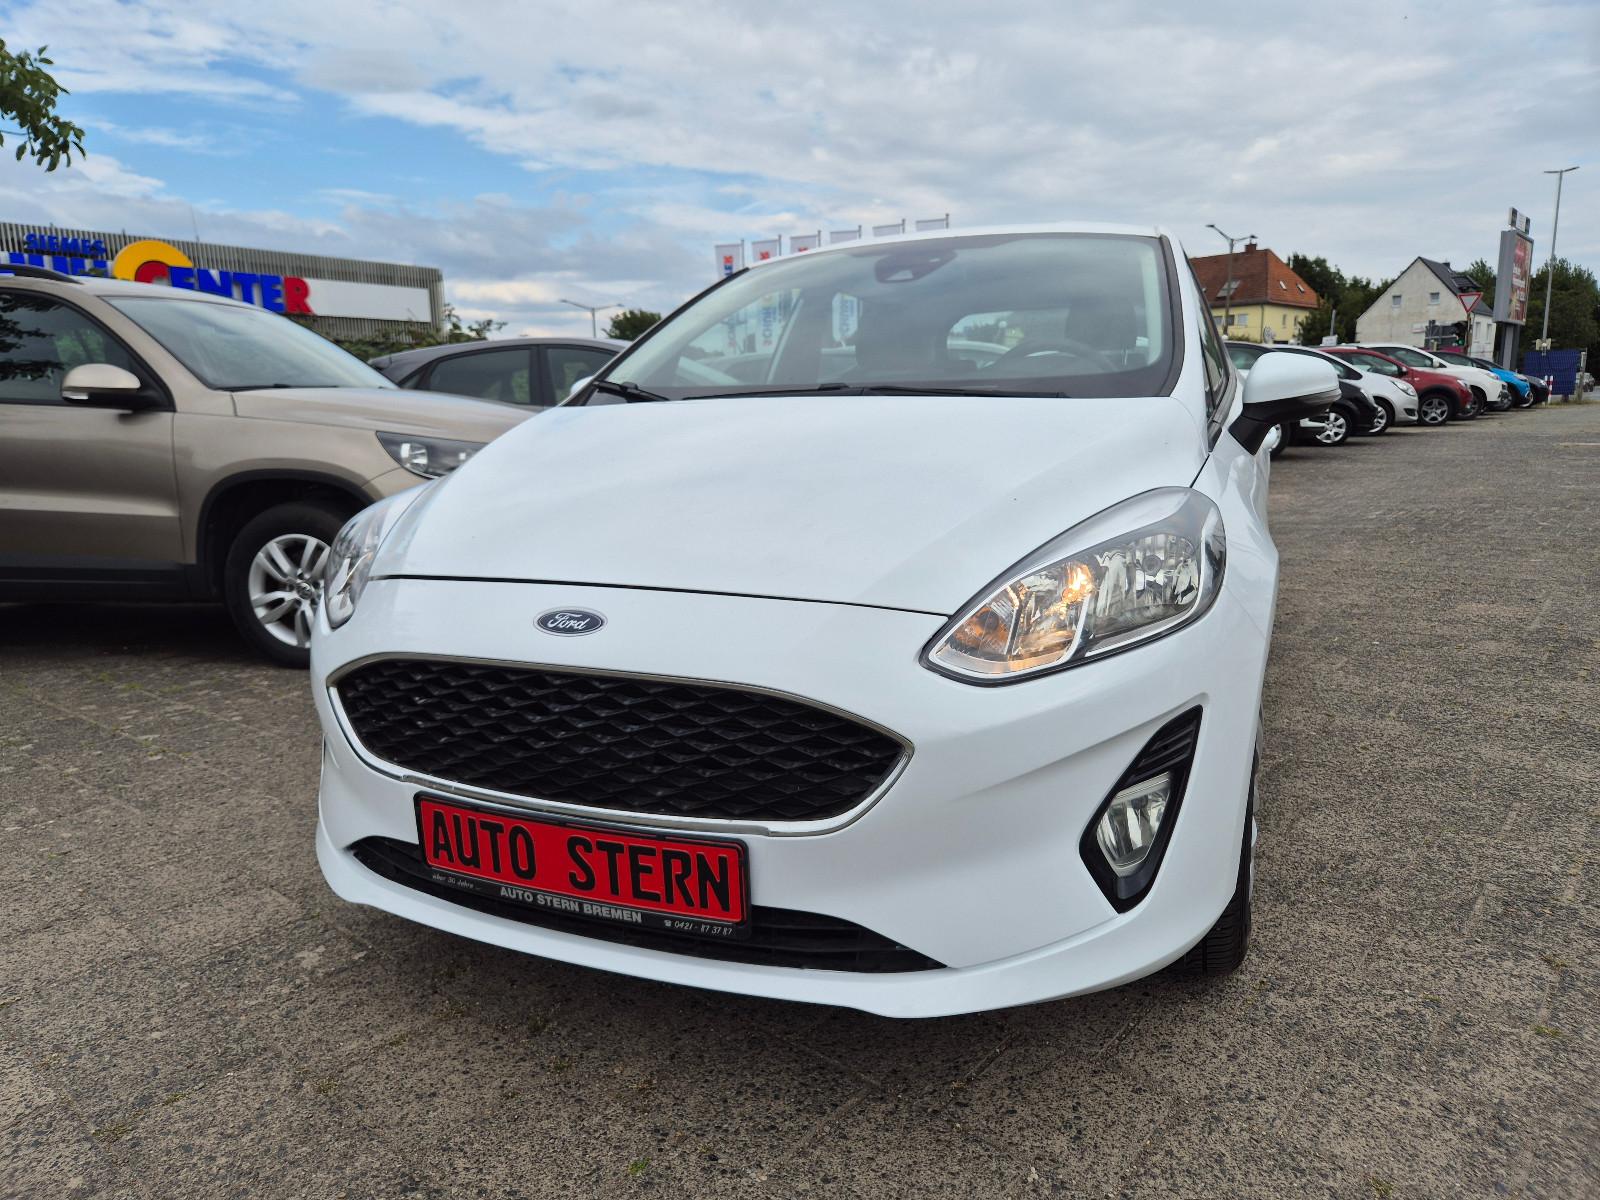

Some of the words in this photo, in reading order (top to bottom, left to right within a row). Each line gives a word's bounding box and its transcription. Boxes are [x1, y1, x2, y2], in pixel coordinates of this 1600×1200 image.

[24, 232, 107, 256] SIEMES
[112, 239, 314, 316] CENTER
[547, 612, 590, 629] Ford
[432, 810, 537, 880] AUTO
[567, 835, 731, 912] STERN
[500, 886, 534, 903] AUTO
[536, 894, 580, 912] STERN
[583, 903, 642, 924] BREMEN
